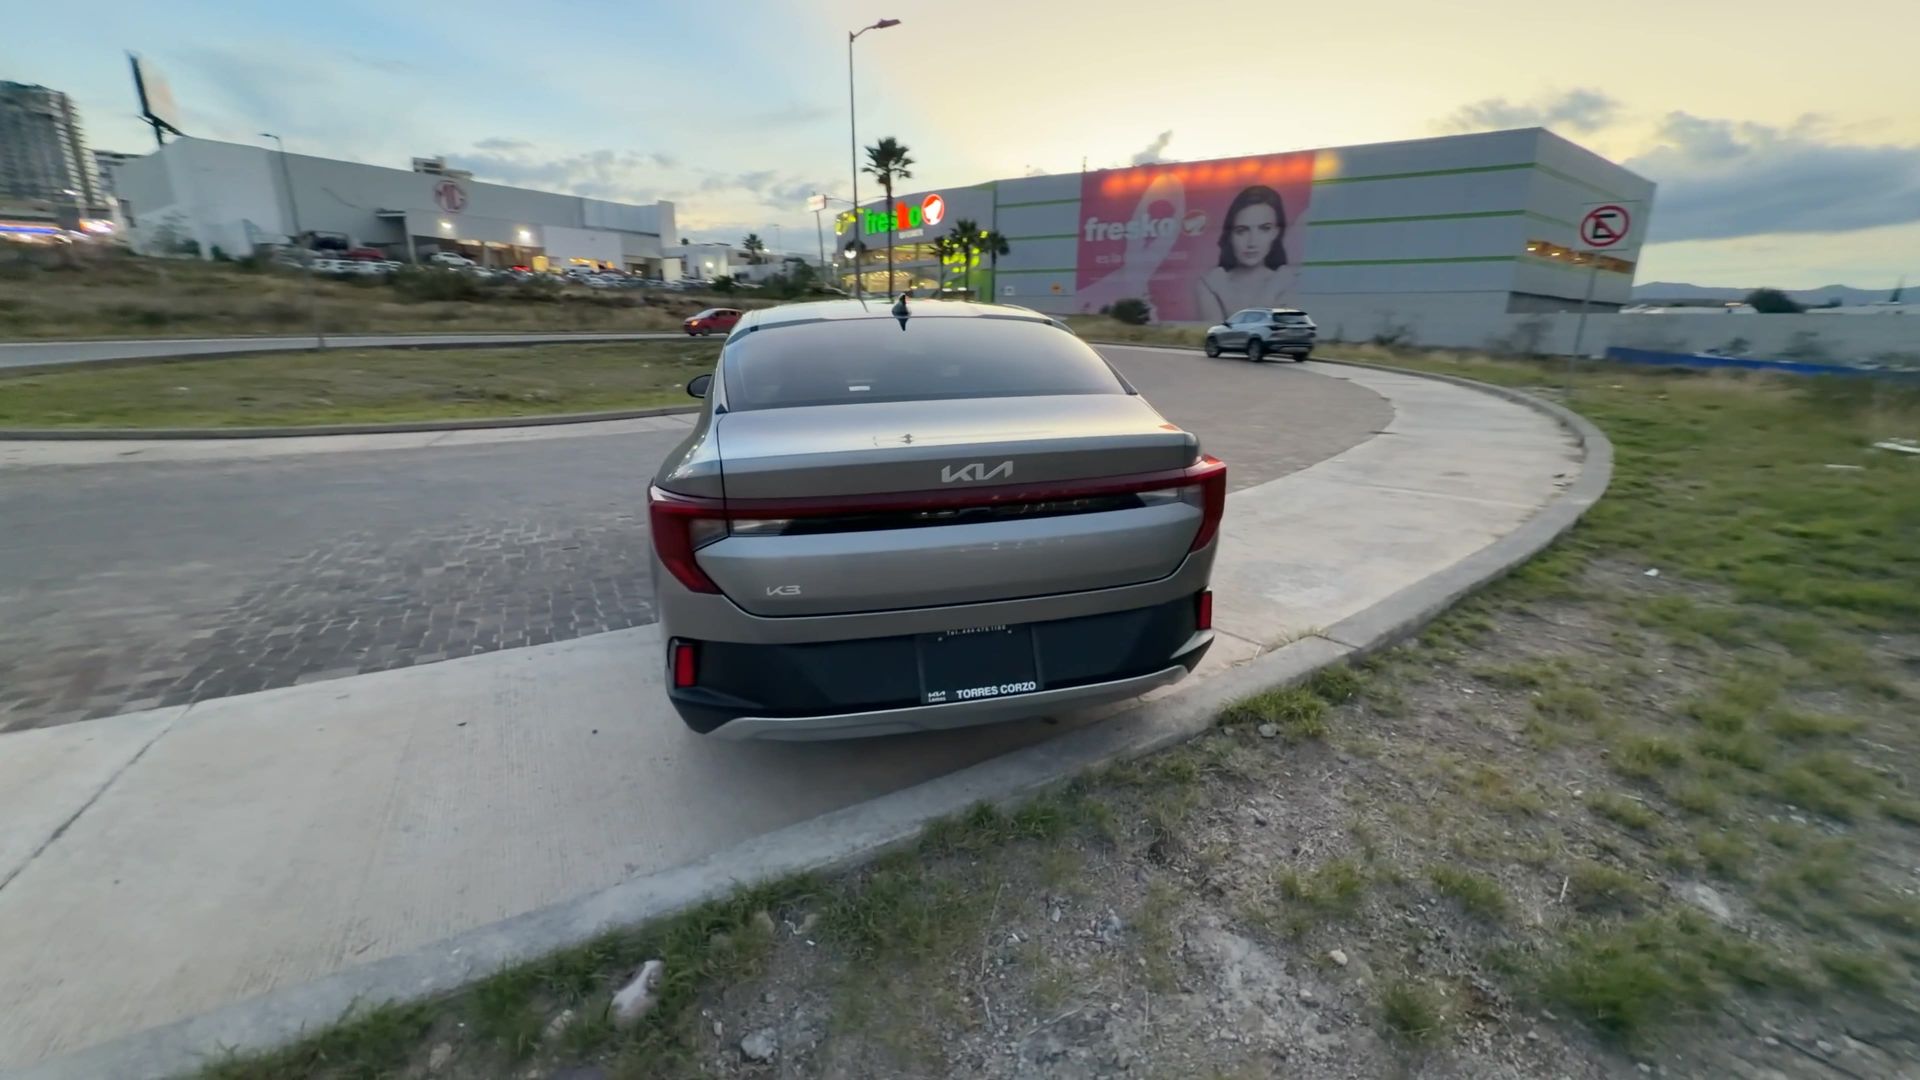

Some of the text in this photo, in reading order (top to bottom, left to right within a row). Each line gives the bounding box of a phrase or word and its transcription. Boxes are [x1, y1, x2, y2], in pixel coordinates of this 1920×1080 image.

[1084, 213, 1177, 242] fresko
[941, 460, 1014, 483] KIA
[766, 585, 801, 596] K3
[956, 681, 1036, 699] TORRES CORZO
